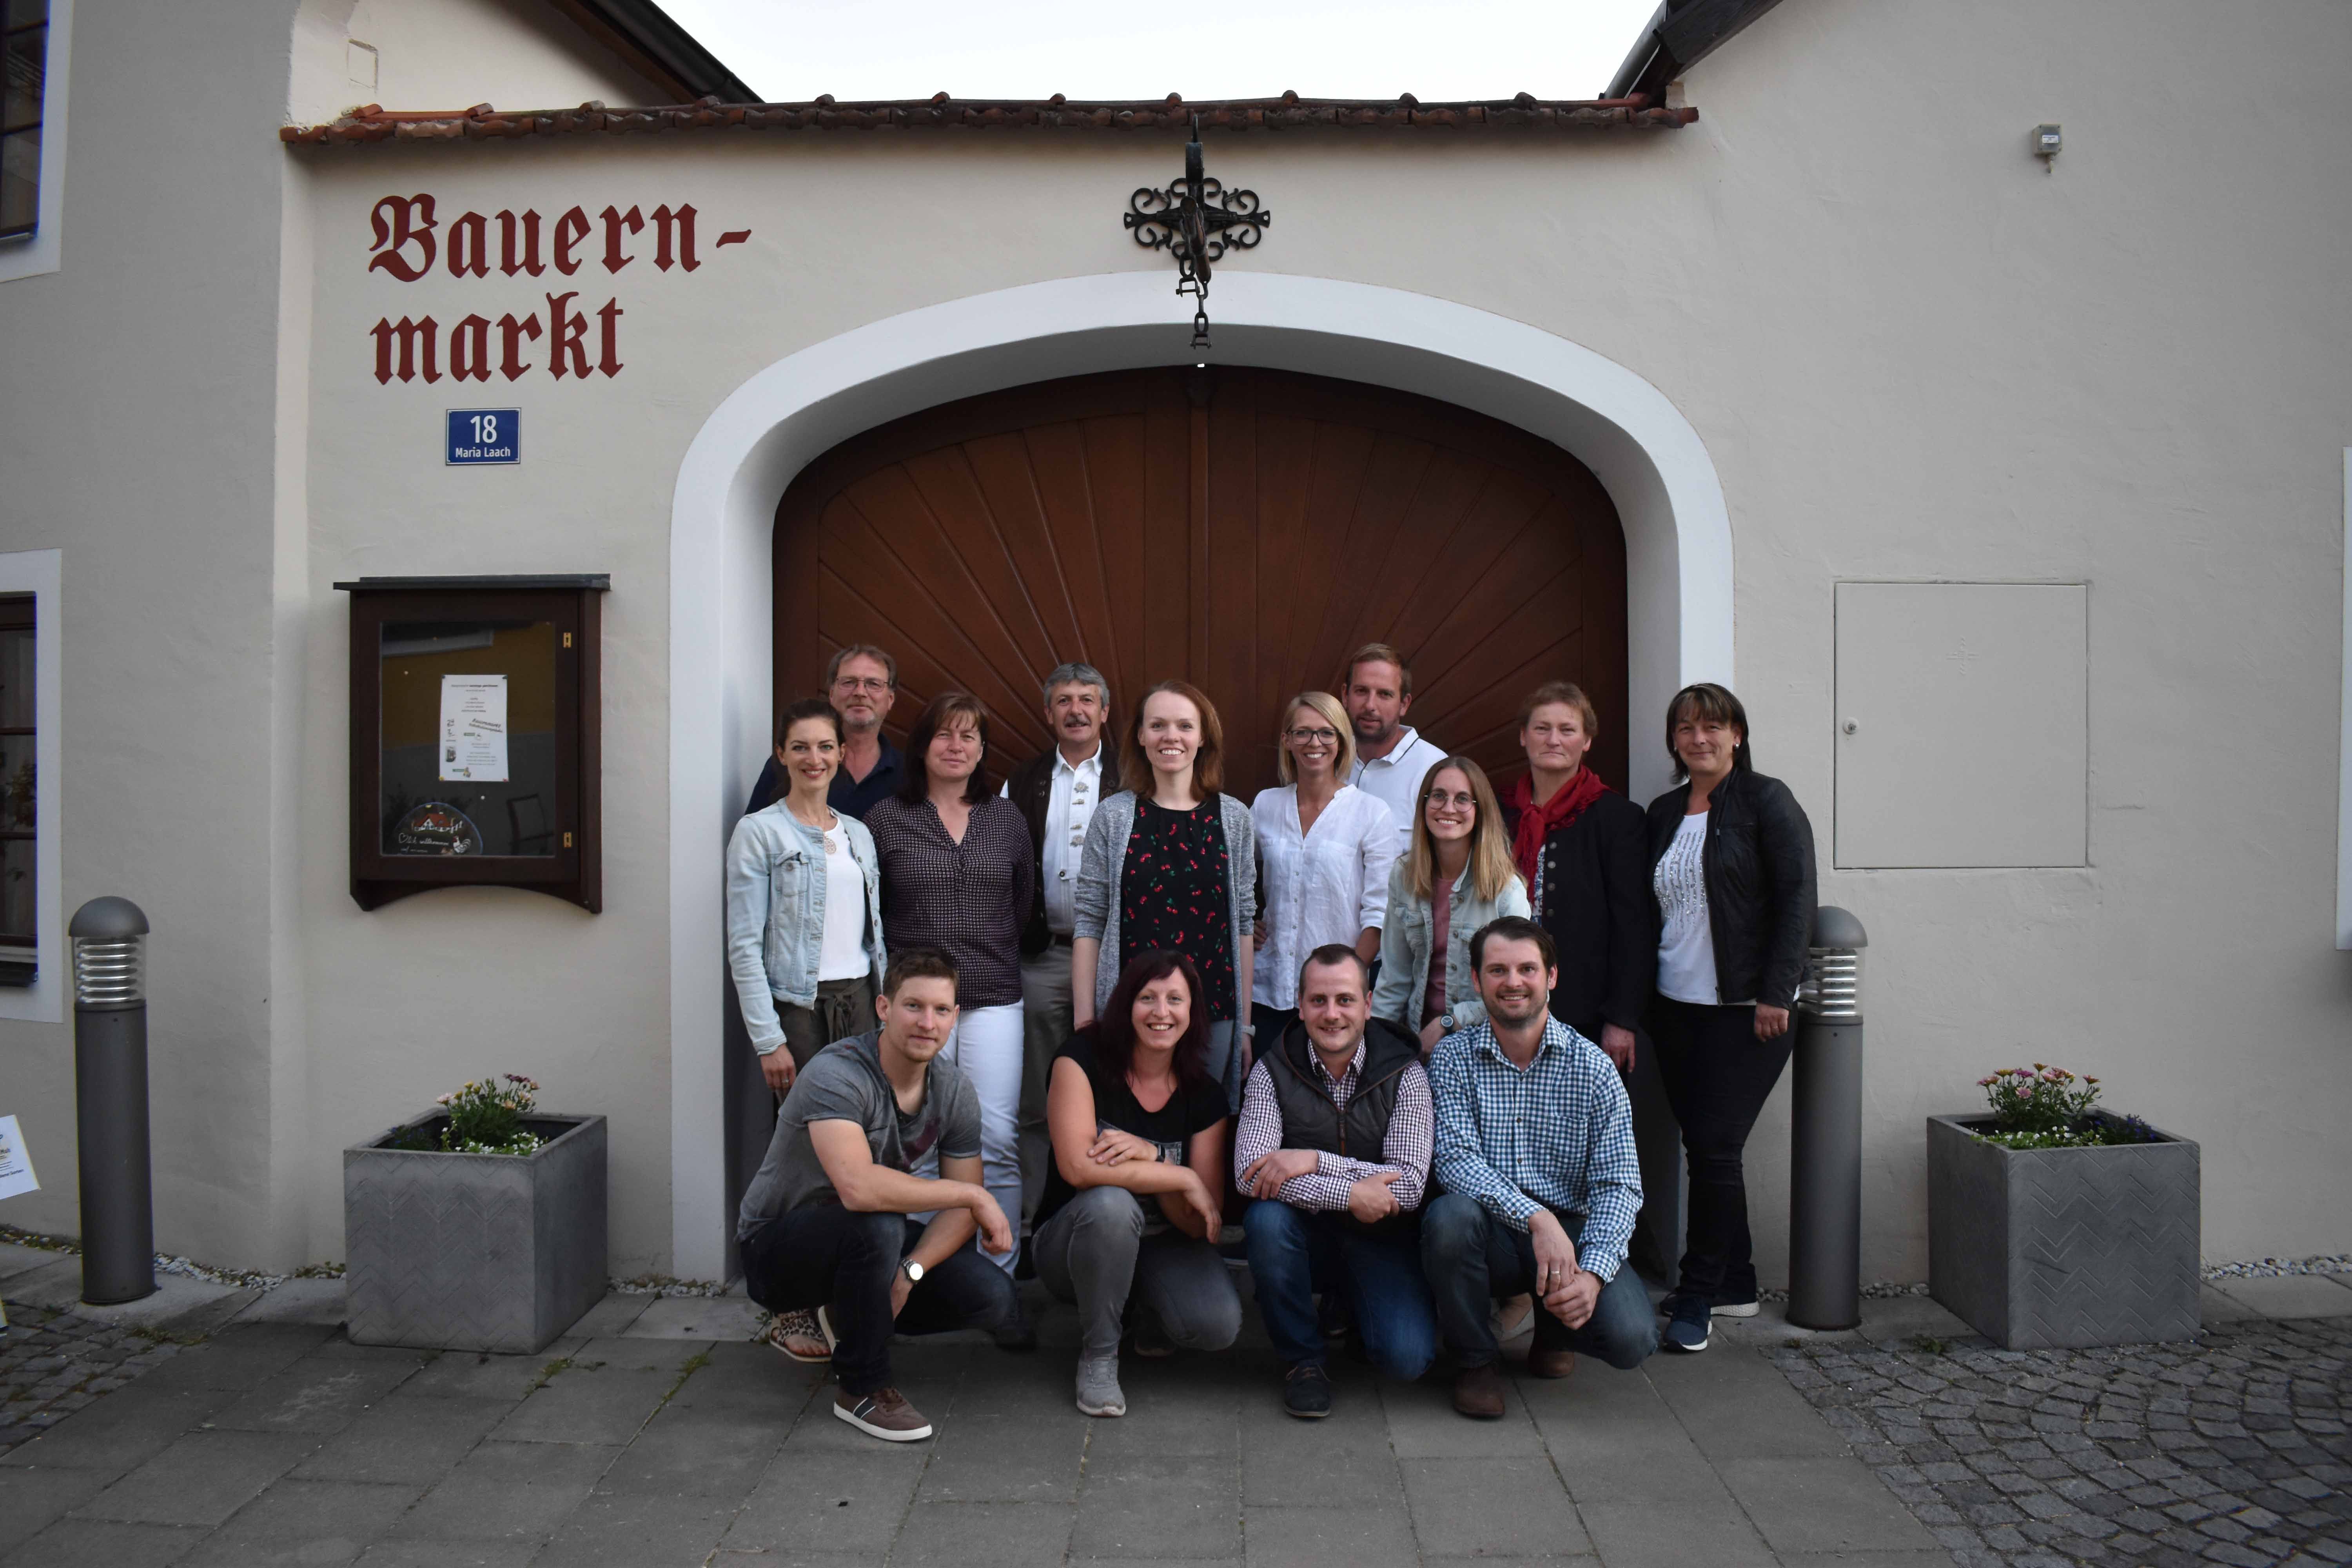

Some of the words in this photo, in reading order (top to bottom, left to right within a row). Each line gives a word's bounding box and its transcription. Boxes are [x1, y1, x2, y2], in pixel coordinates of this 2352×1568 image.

[368, 193, 752, 282] Bauern-
[369, 292, 624, 385] markt
[456, 446, 481, 458] Maria
[484, 446, 510, 457] Laach
[470, 415, 497, 443] 18
